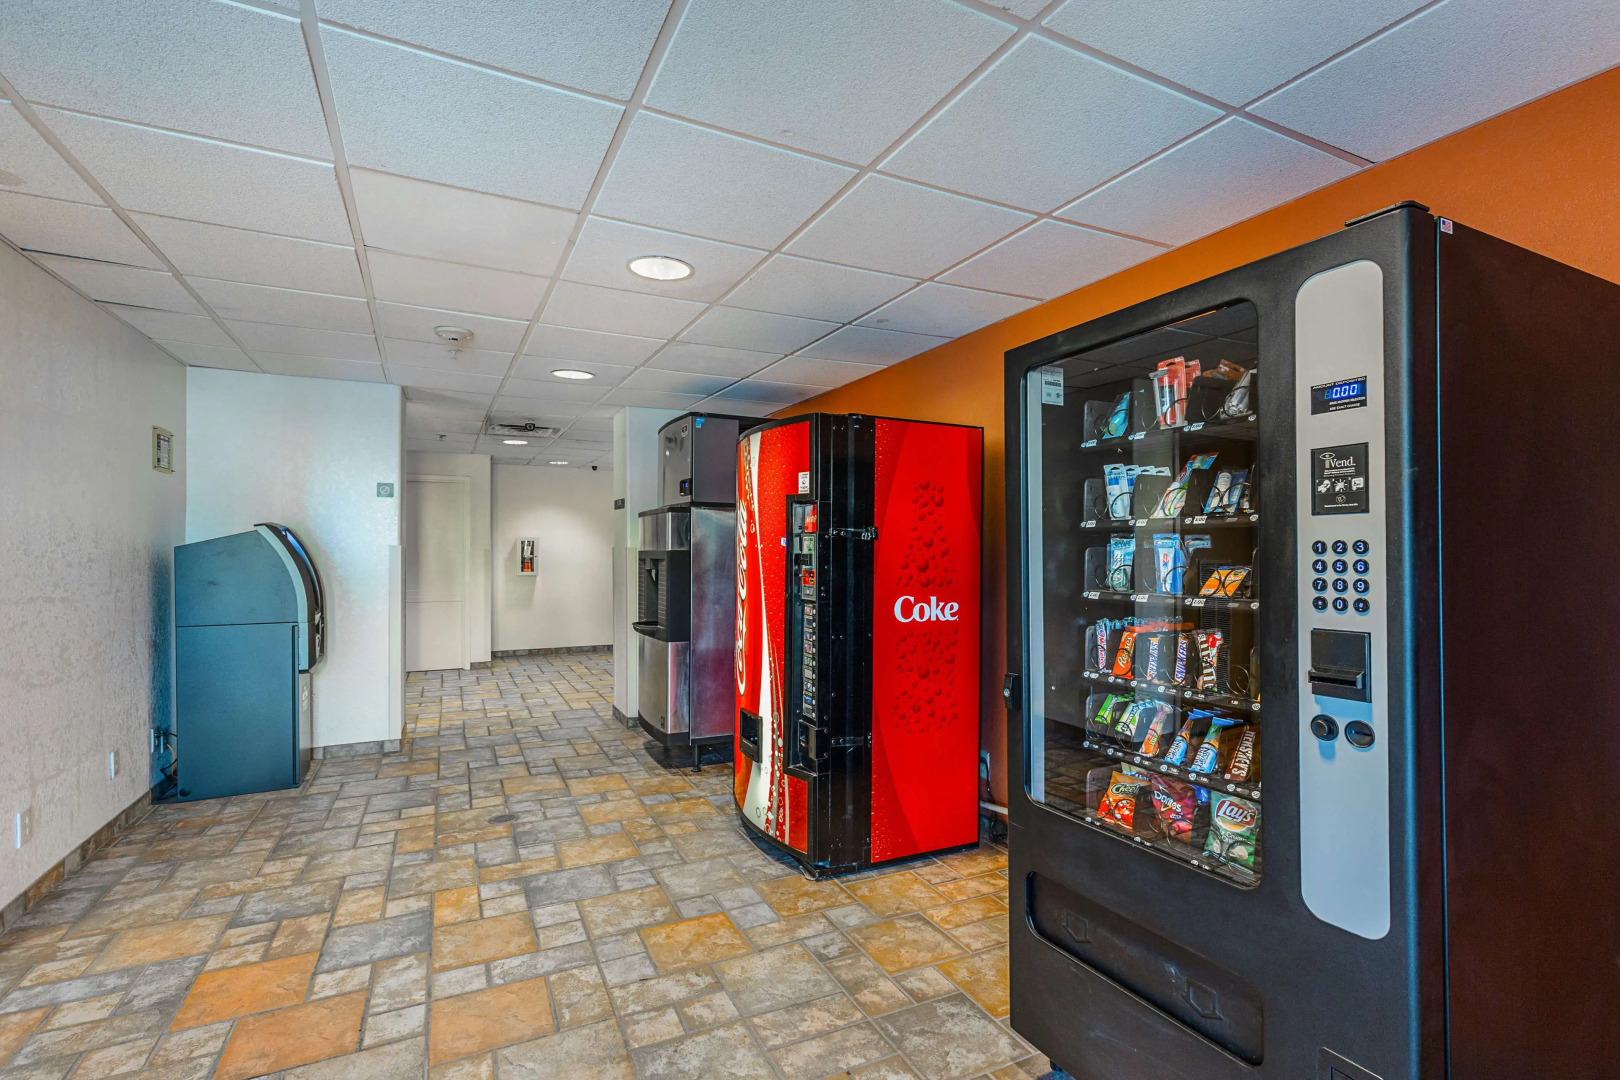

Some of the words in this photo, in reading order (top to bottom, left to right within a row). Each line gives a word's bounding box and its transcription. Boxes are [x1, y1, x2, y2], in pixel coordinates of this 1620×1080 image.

[1312, 382, 1335, 390] AMOUNT
[1316, 542, 1322, 552] 1
[1336, 542, 1343, 552] 2
[1356, 541, 1364, 552] 3
[1316, 561, 1323, 571] 4
[1336, 561, 1343, 571] 5
[1356, 561, 1365, 571] 6
[1316, 580, 1323, 590] 7
[1336, 580, 1343, 590] 8
[1357, 581, 1365, 591] 9
[894, 595, 960, 623] Coke
[1336, 599, 1343, 609] 0
[1175, 640, 1188, 683] SNICKERS
[1154, 790, 1182, 812] Doritos
